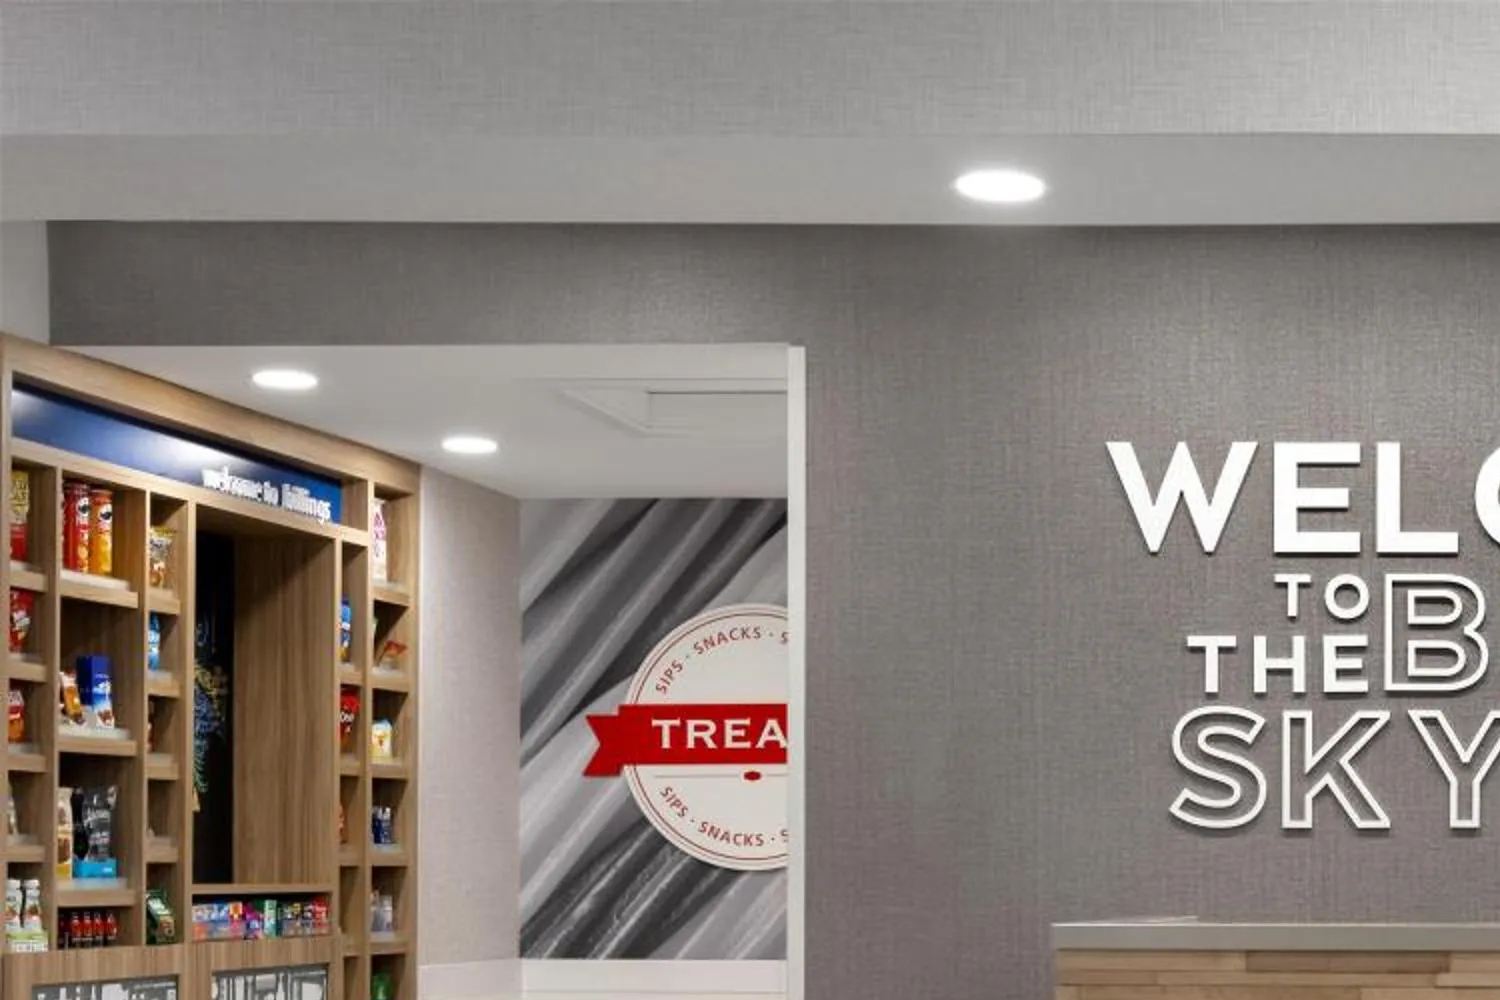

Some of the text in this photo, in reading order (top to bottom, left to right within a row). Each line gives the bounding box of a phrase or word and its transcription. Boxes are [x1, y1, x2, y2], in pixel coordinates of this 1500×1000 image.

[1274, 572, 1370, 620] TO
[655, 659, 684, 695] SIPS
[693, 626, 761, 655] SNACKS
[1187, 634, 1370, 695] THE
[651, 718, 788, 750] TREA
[660, 786, 689, 818] SIPS
[698, 821, 765, 847] SNACKS
